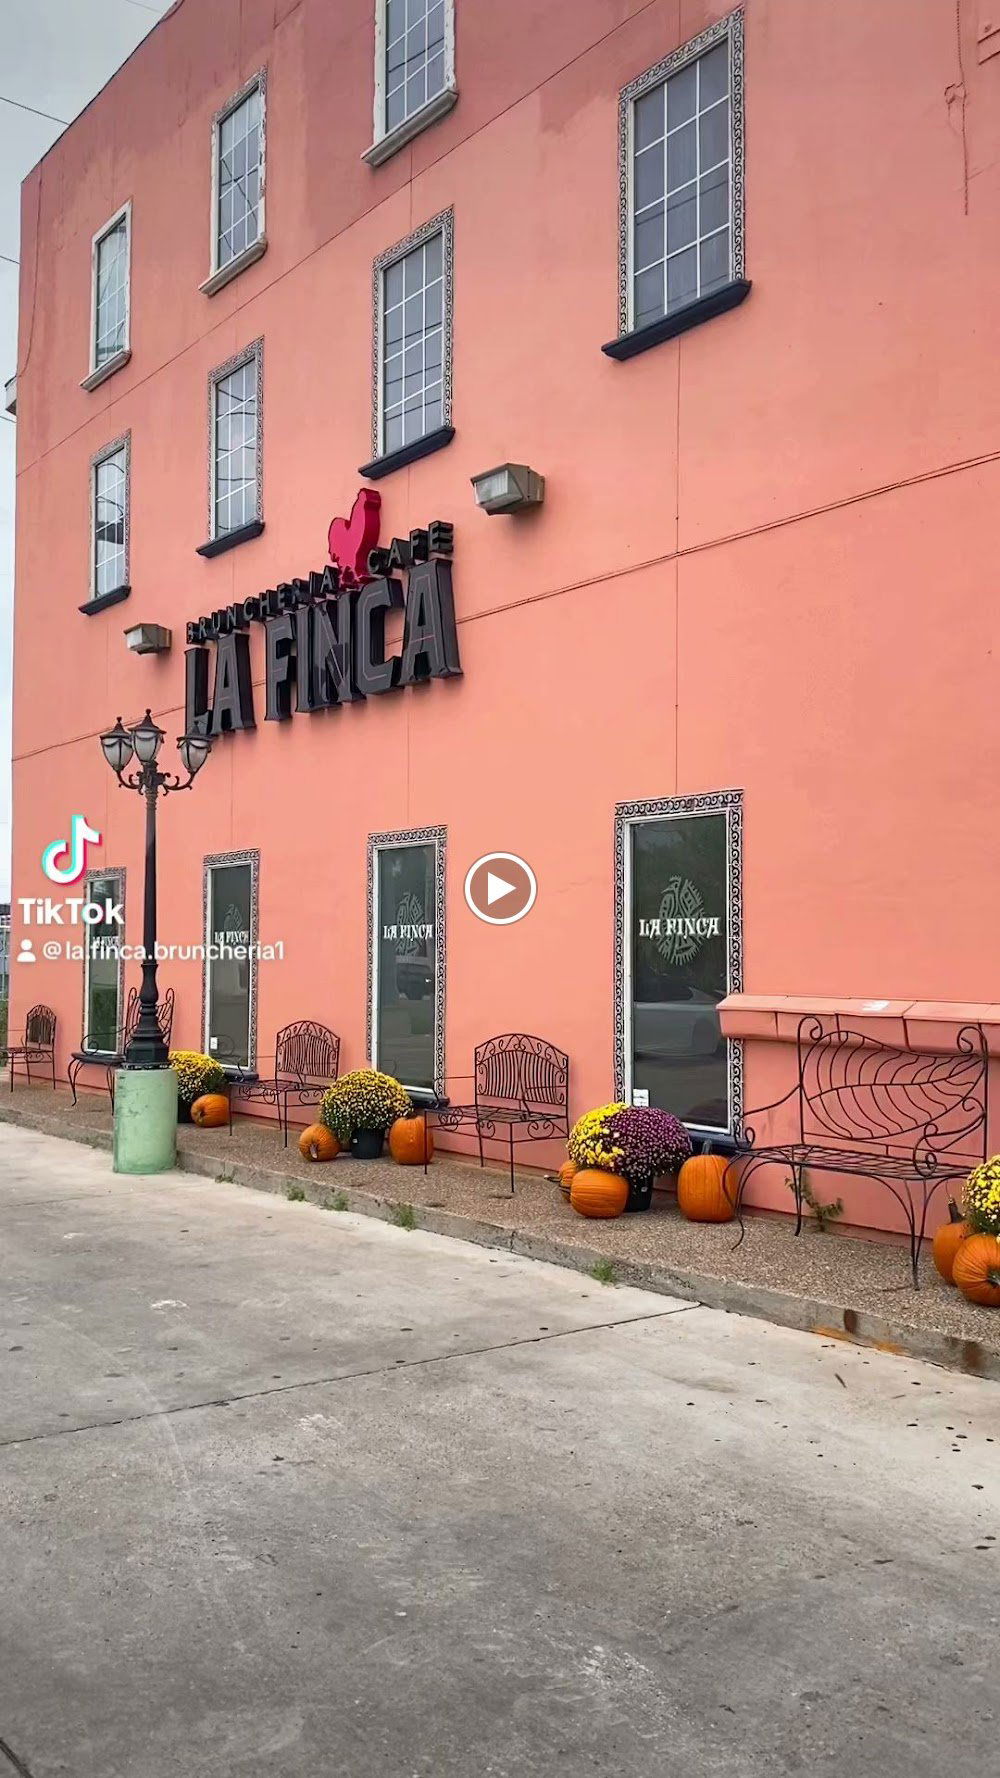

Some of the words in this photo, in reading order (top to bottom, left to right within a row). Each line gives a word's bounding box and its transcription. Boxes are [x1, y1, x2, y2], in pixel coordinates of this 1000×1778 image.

[186, 565, 340, 645] BRUNCHERIA
[366, 520, 454, 577] CAFE
[184, 632, 256, 737] LA
[264, 558, 463, 721] FINCA
[383, 925, 397, 940] LA
[400, 924, 433, 942] FINCA
[638, 918, 661, 939] LA
[665, 917, 720, 940] FINCA
